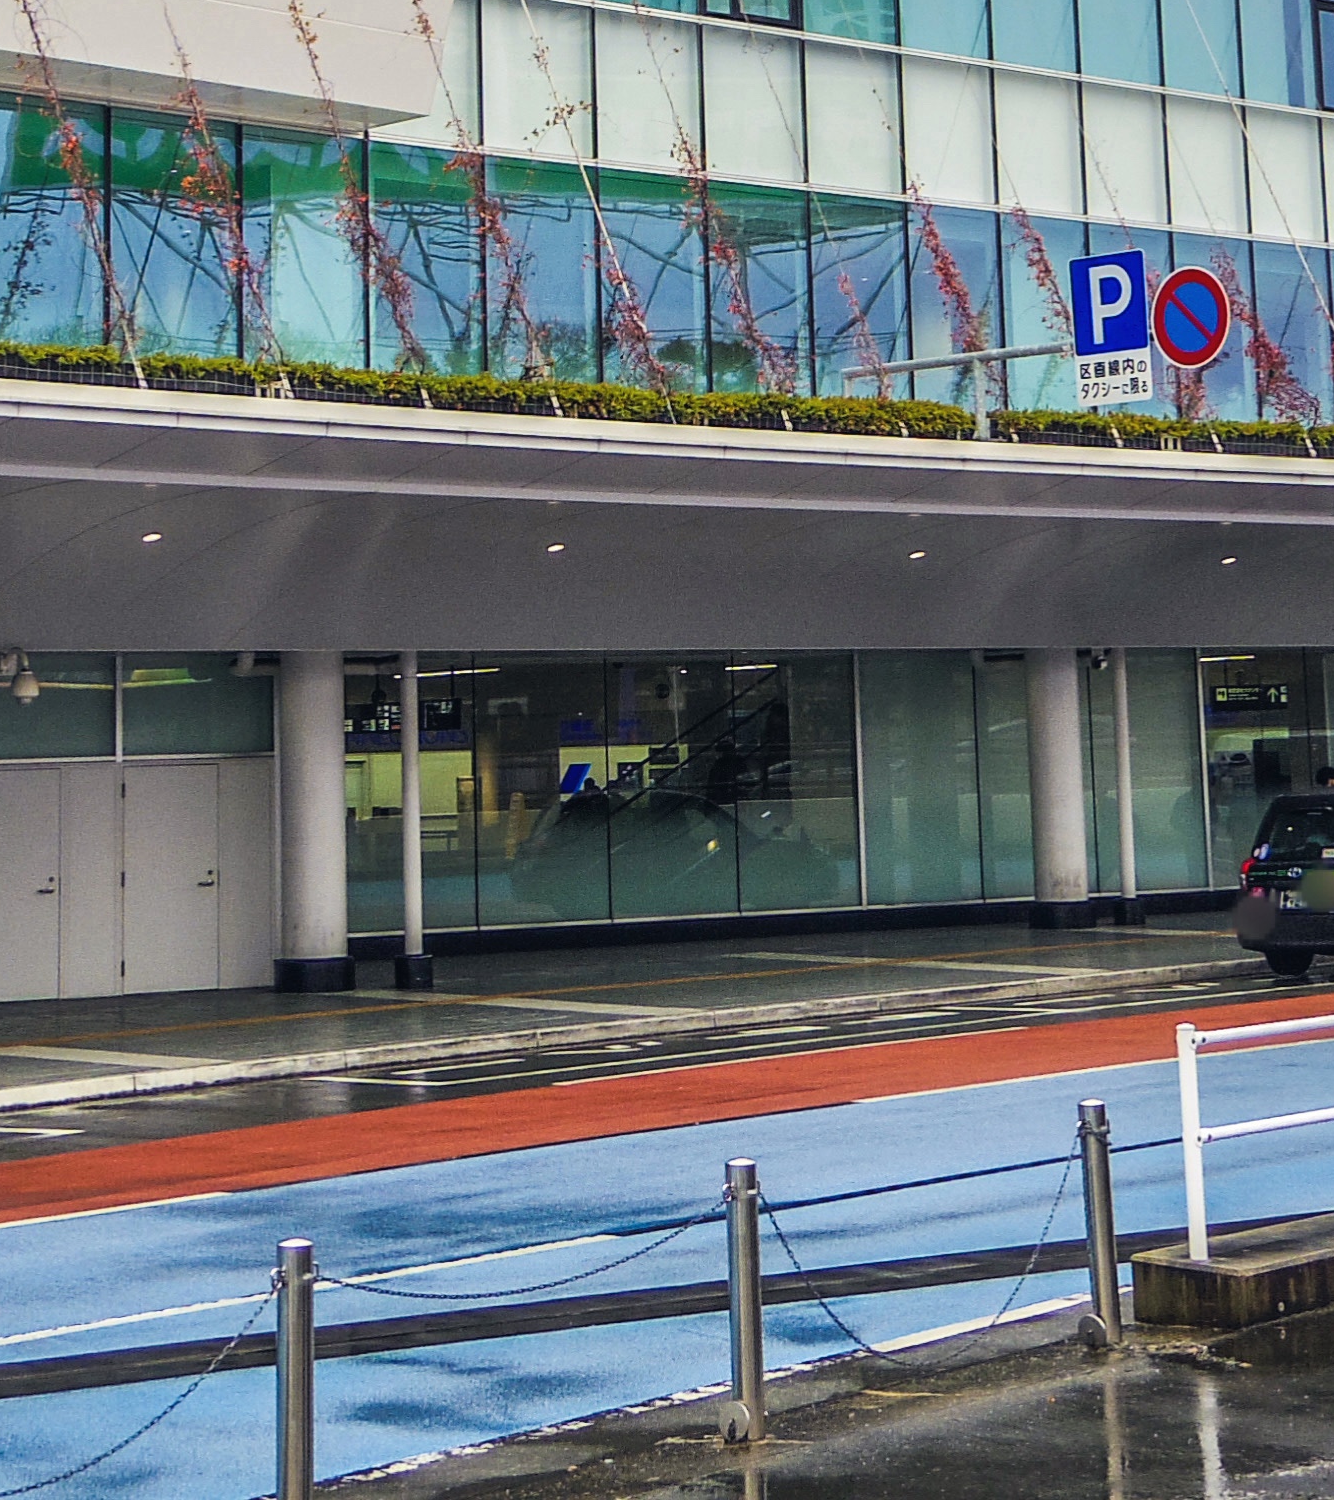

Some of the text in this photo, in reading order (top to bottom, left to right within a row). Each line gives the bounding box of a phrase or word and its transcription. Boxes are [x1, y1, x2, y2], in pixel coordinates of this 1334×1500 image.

[1088, 264, 1132, 345] P
[1080, 377, 1148, 400] タクシーに限る
